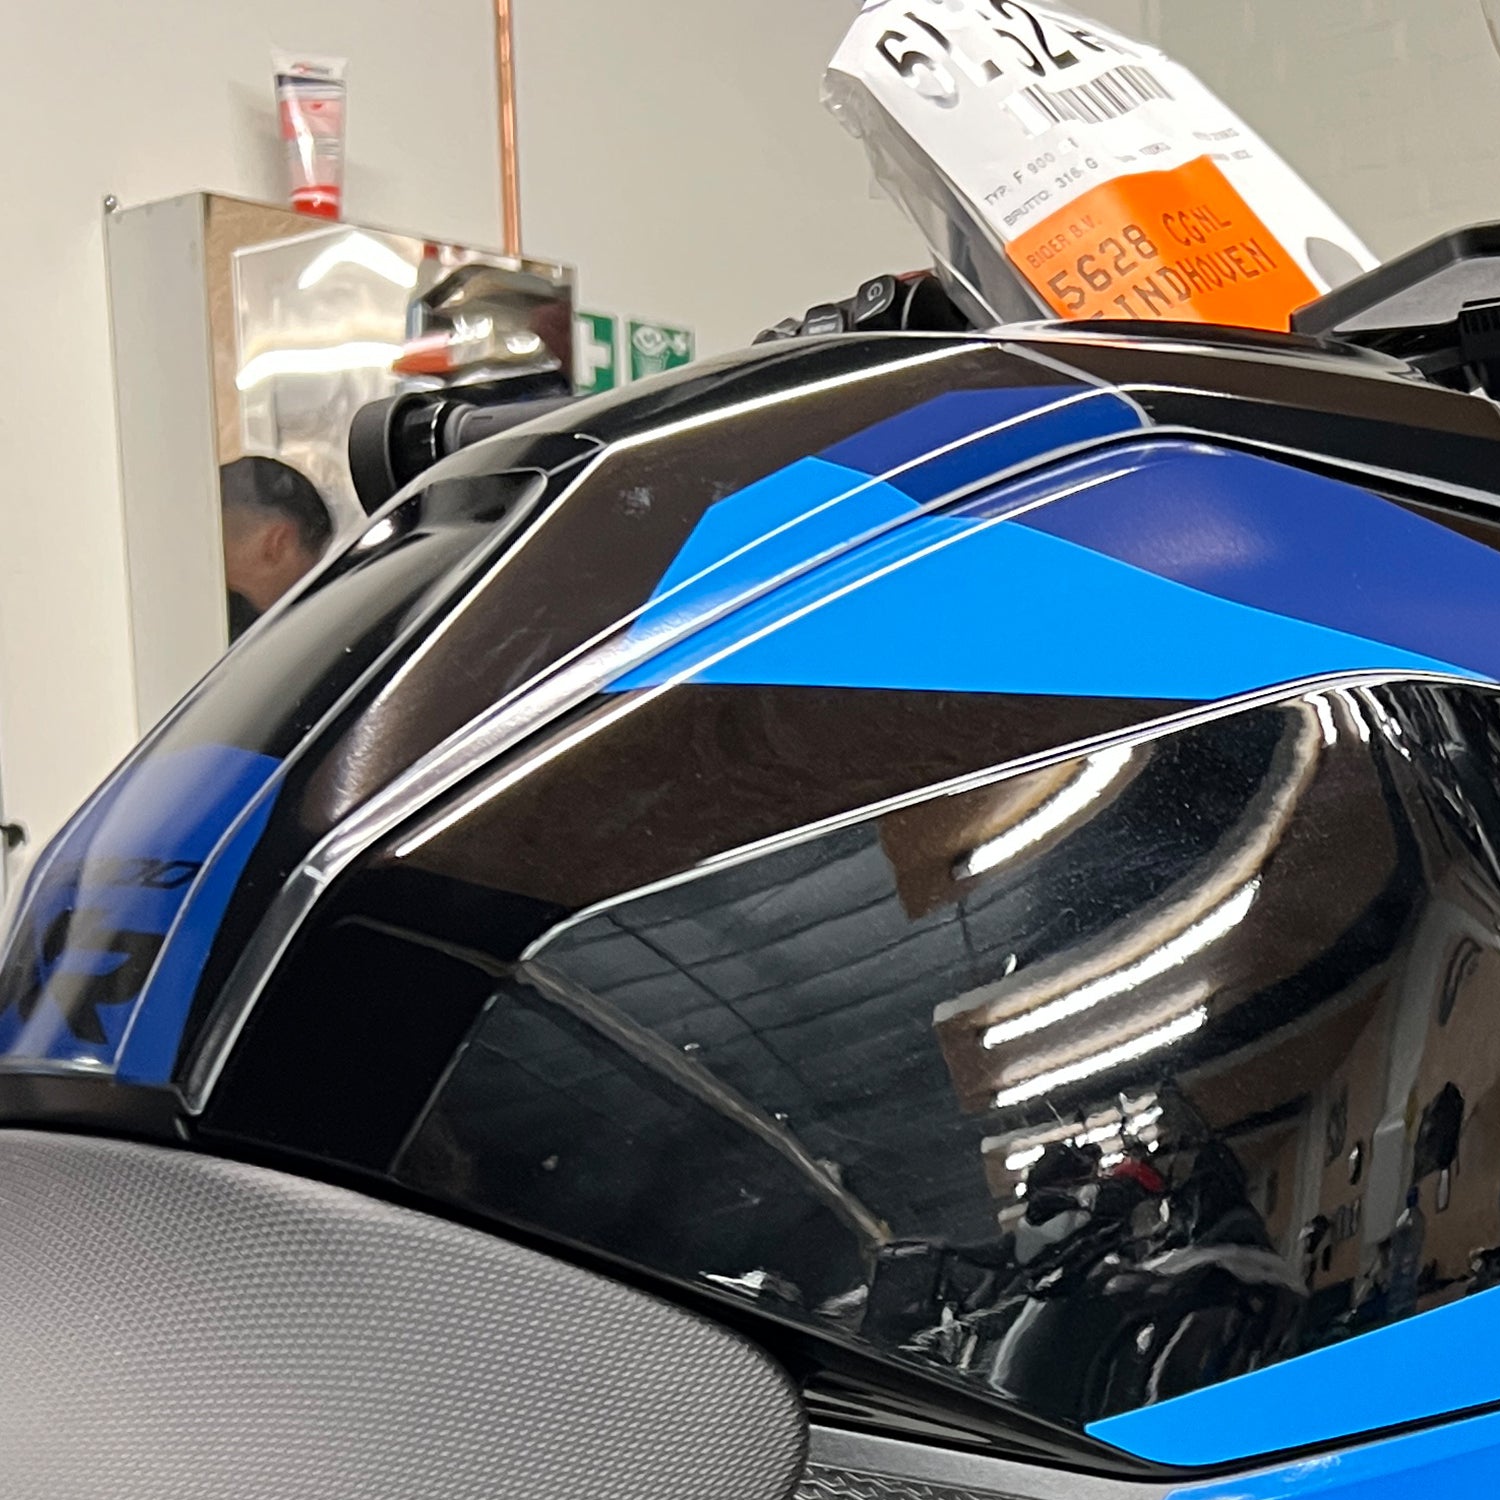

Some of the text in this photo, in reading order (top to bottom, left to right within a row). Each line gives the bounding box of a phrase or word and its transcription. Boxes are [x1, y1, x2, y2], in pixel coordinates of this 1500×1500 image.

[1012, 169, 1023, 185] F
[1026, 152, 1056, 174] 900
[1047, 223, 1159, 310] 5628
